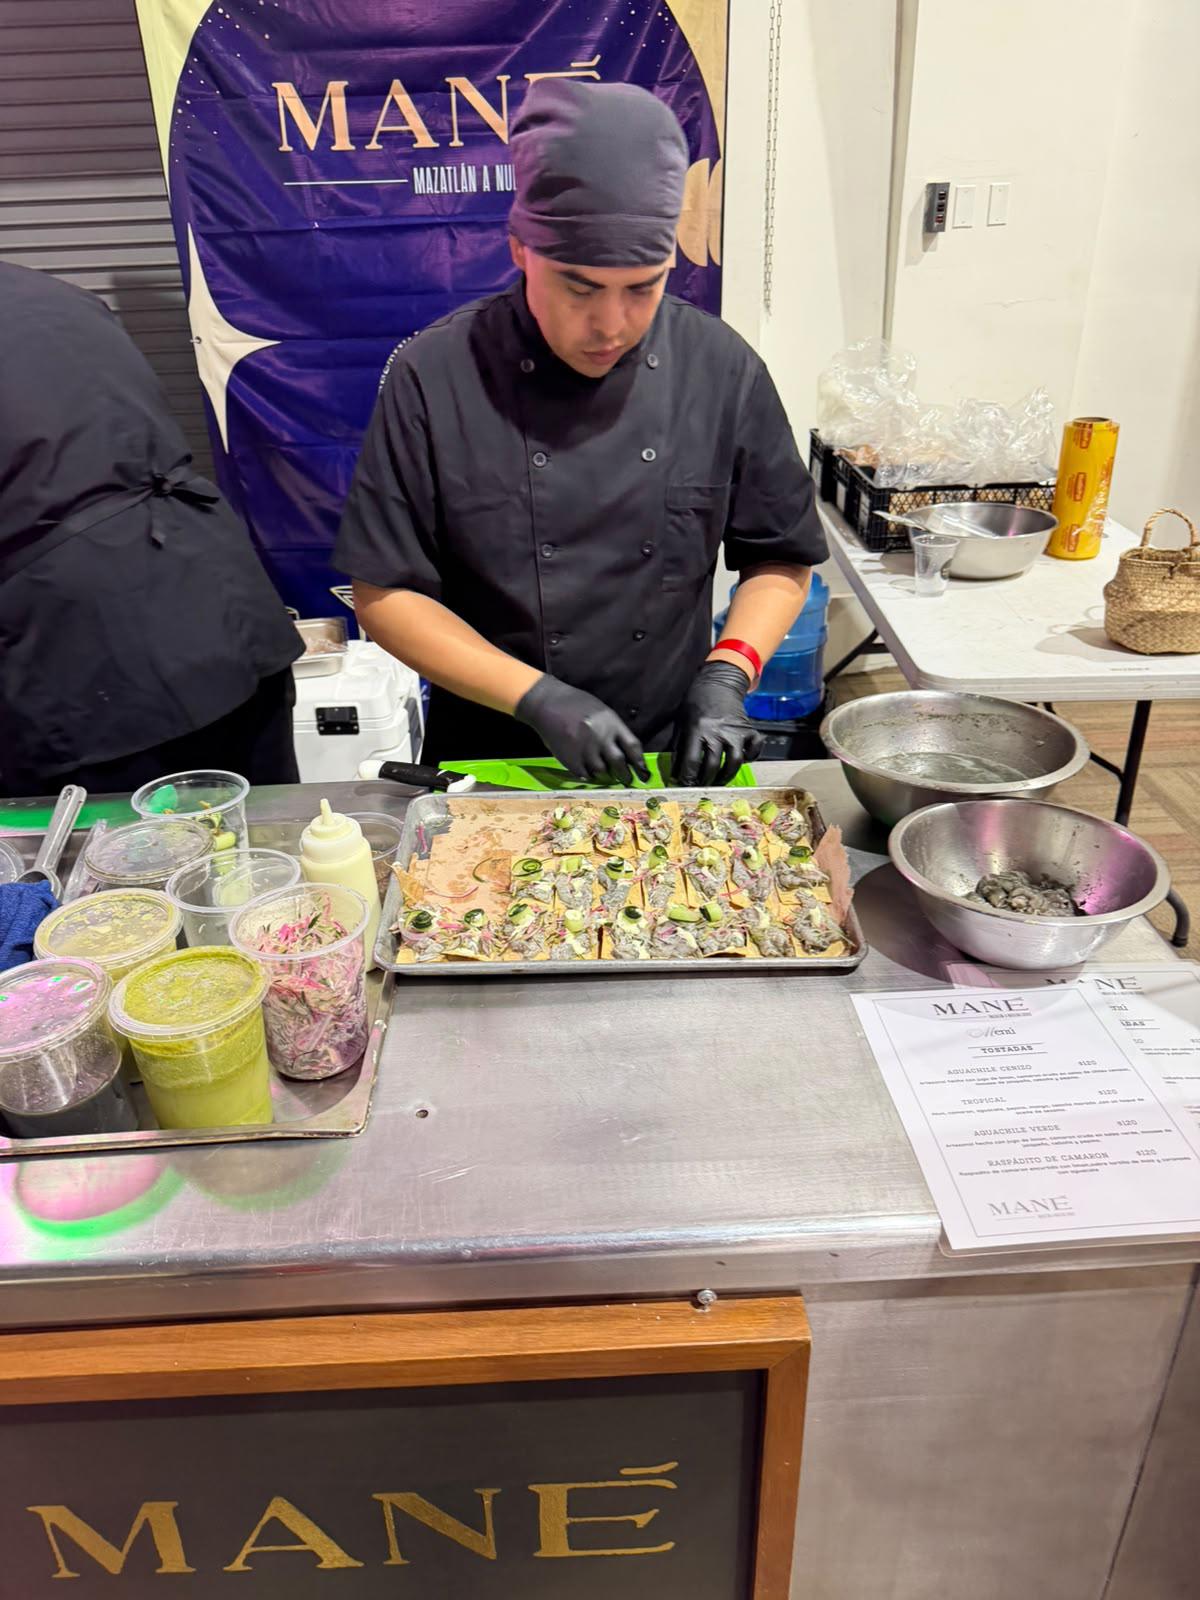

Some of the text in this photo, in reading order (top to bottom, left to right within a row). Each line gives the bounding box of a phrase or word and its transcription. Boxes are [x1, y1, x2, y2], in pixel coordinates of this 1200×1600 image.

[271, 54, 601, 152] MAN
[412, 162, 478, 195] MAZATLÁN
[482, 164, 491, 193] A
[980, 1045, 1034, 1054] TOSTADAS
[946, 1065, 998, 1076] AGUACHILE
[960, 1096, 1008, 1106] TROPICAL
[973, 1126, 1028, 1137] AGUACHILE
[26, 1460, 679, 1579] MANÉ
